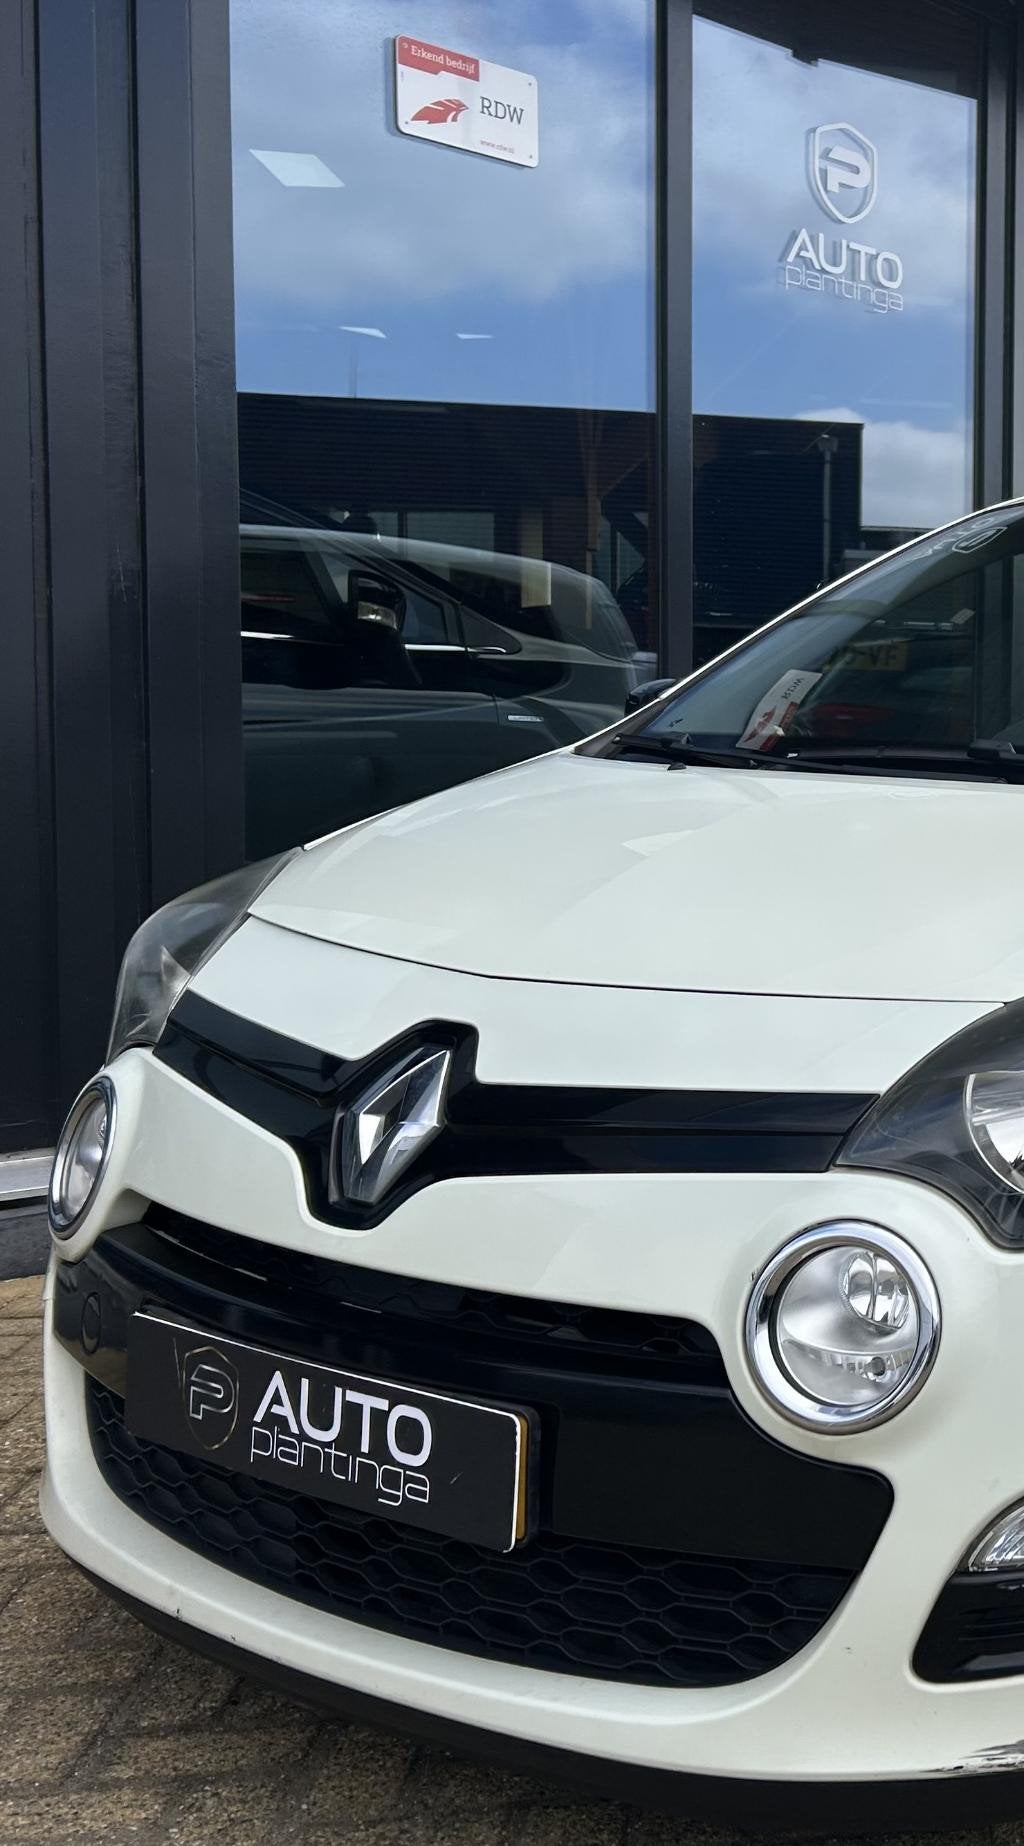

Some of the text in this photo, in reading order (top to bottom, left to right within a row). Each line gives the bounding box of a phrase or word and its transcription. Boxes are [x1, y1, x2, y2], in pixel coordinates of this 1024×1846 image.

[411, 45, 476, 74] Erkend bedrijf
[479, 95, 525, 125] RDW
[786, 227, 903, 290] AUTO
[784, 264, 904, 314] plantinga
[252, 1370, 433, 1467] AUTO
[250, 1426, 430, 1506] plantinga
